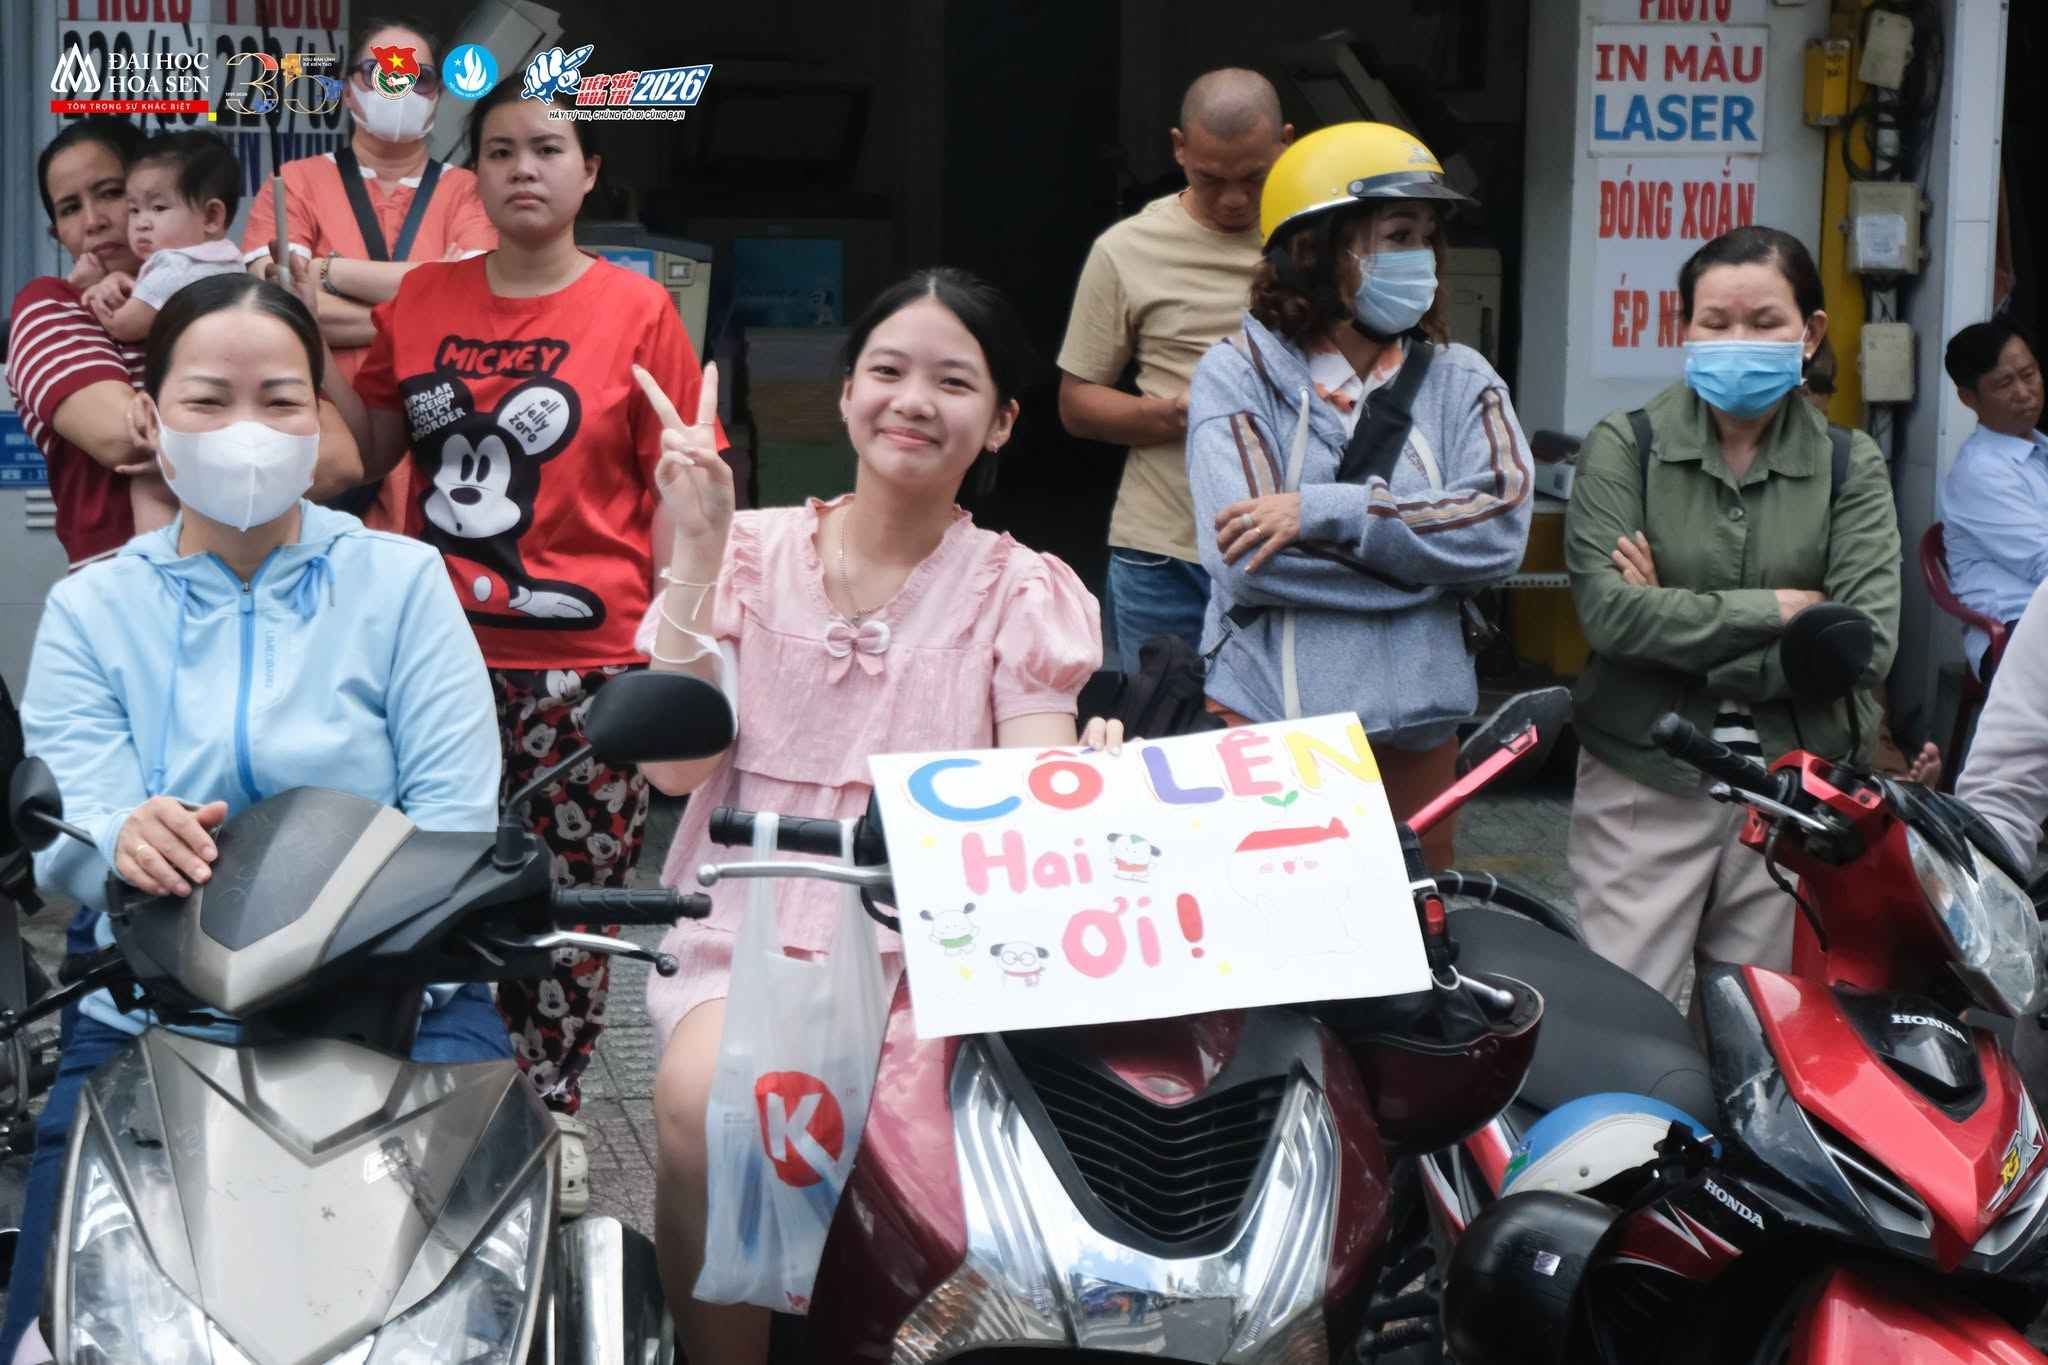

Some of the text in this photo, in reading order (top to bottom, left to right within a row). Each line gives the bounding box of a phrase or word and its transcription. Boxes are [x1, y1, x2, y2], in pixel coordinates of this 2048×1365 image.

[1595, 31, 1763, 84] IN MÀU
[1594, 94, 1758, 141] LASER
[1598, 163, 1674, 240] ĐÓNG
[1611, 271, 1650, 348] ÉP
[438, 339, 566, 377] MICKEY
[1140, 722, 1382, 805] LÊN
[961, 829, 1093, 895] Hai
[1890, 1013, 1969, 1045] HONDA
[765, 1089, 844, 1187] K
[1703, 1177, 1766, 1230] HONDA
